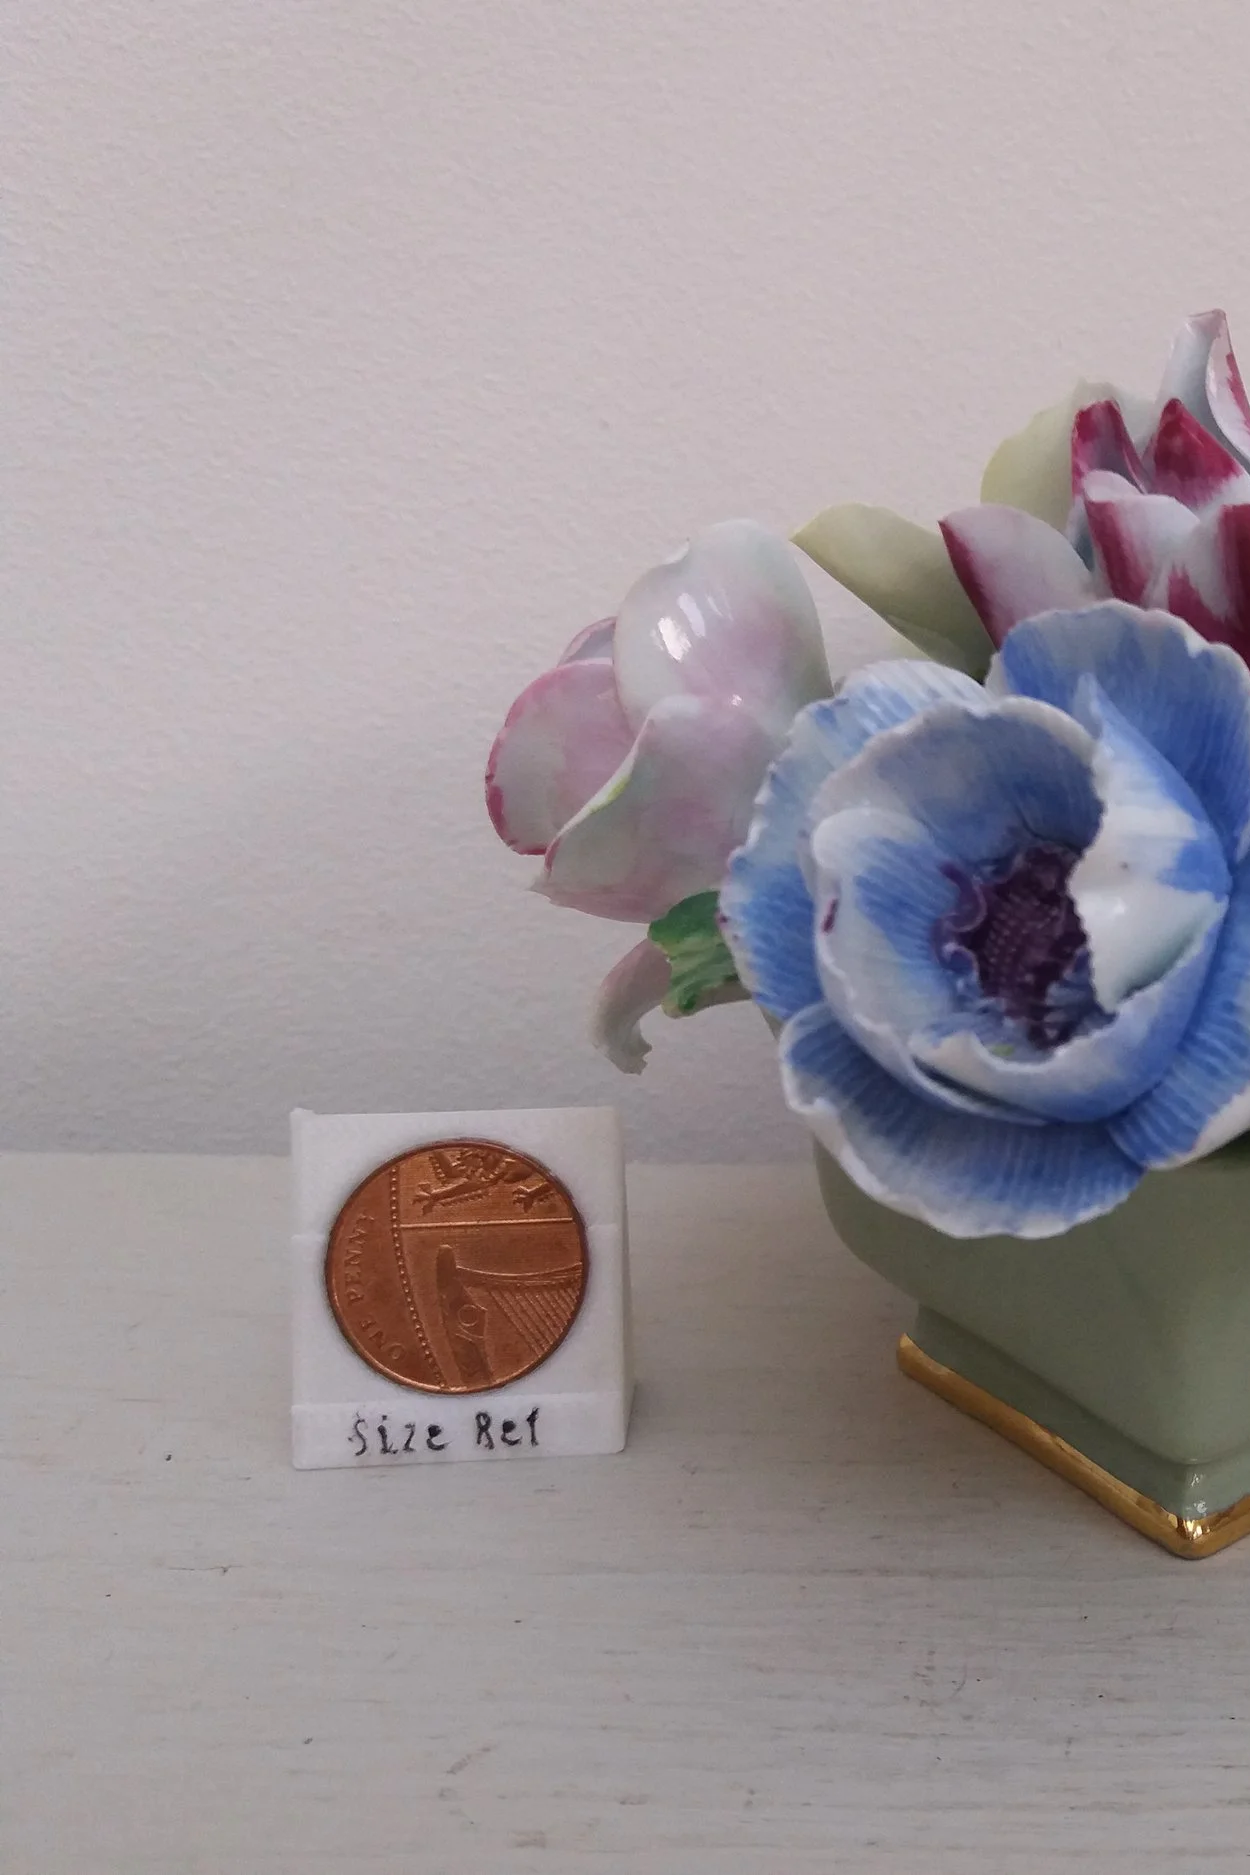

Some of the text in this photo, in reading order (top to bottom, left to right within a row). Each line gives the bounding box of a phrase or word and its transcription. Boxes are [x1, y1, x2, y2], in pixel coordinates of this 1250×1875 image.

[344, 1211, 406, 1362] ONE PENNY
[347, 1411, 448, 1457] Size
